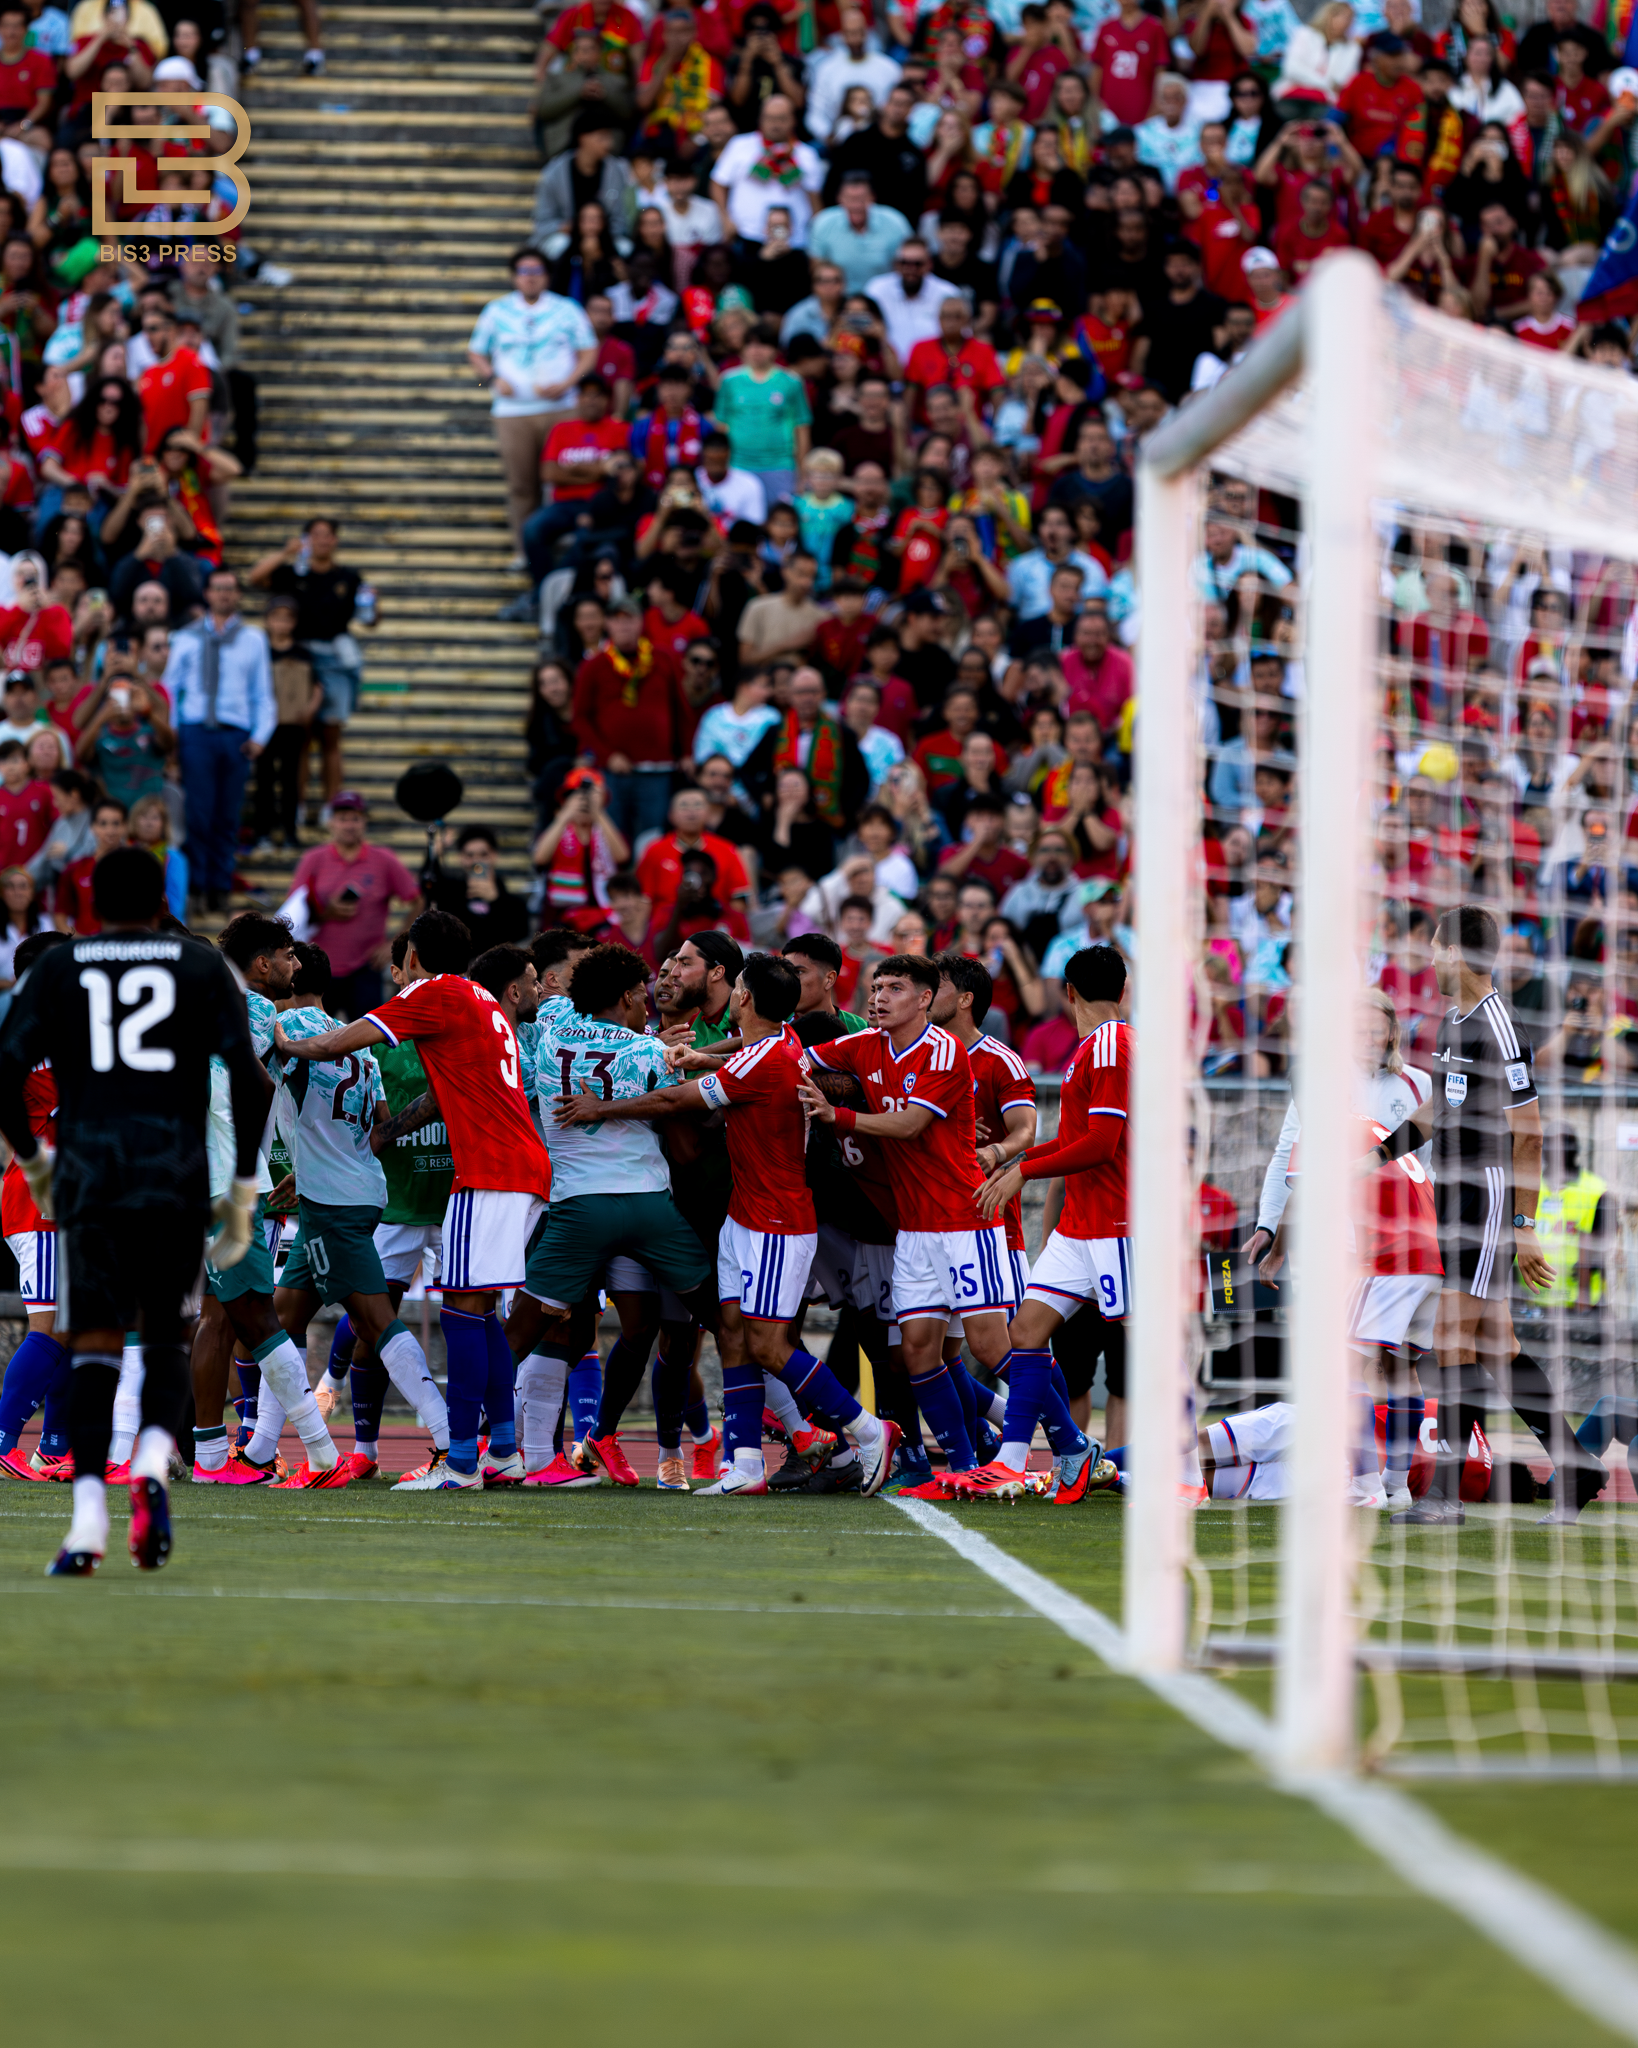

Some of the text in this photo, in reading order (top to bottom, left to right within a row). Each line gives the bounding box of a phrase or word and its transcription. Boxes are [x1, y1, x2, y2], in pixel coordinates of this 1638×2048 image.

[79, 967, 177, 1072] 12
[492, 1010, 518, 1089] 3
[555, 1047, 617, 1103] 13
[1447, 1074, 1466, 1086] FIFA
[836, 1135, 865, 1168] 6
[948, 1263, 978, 1300] 25
[1222, 1258, 1234, 1304] FORZA
